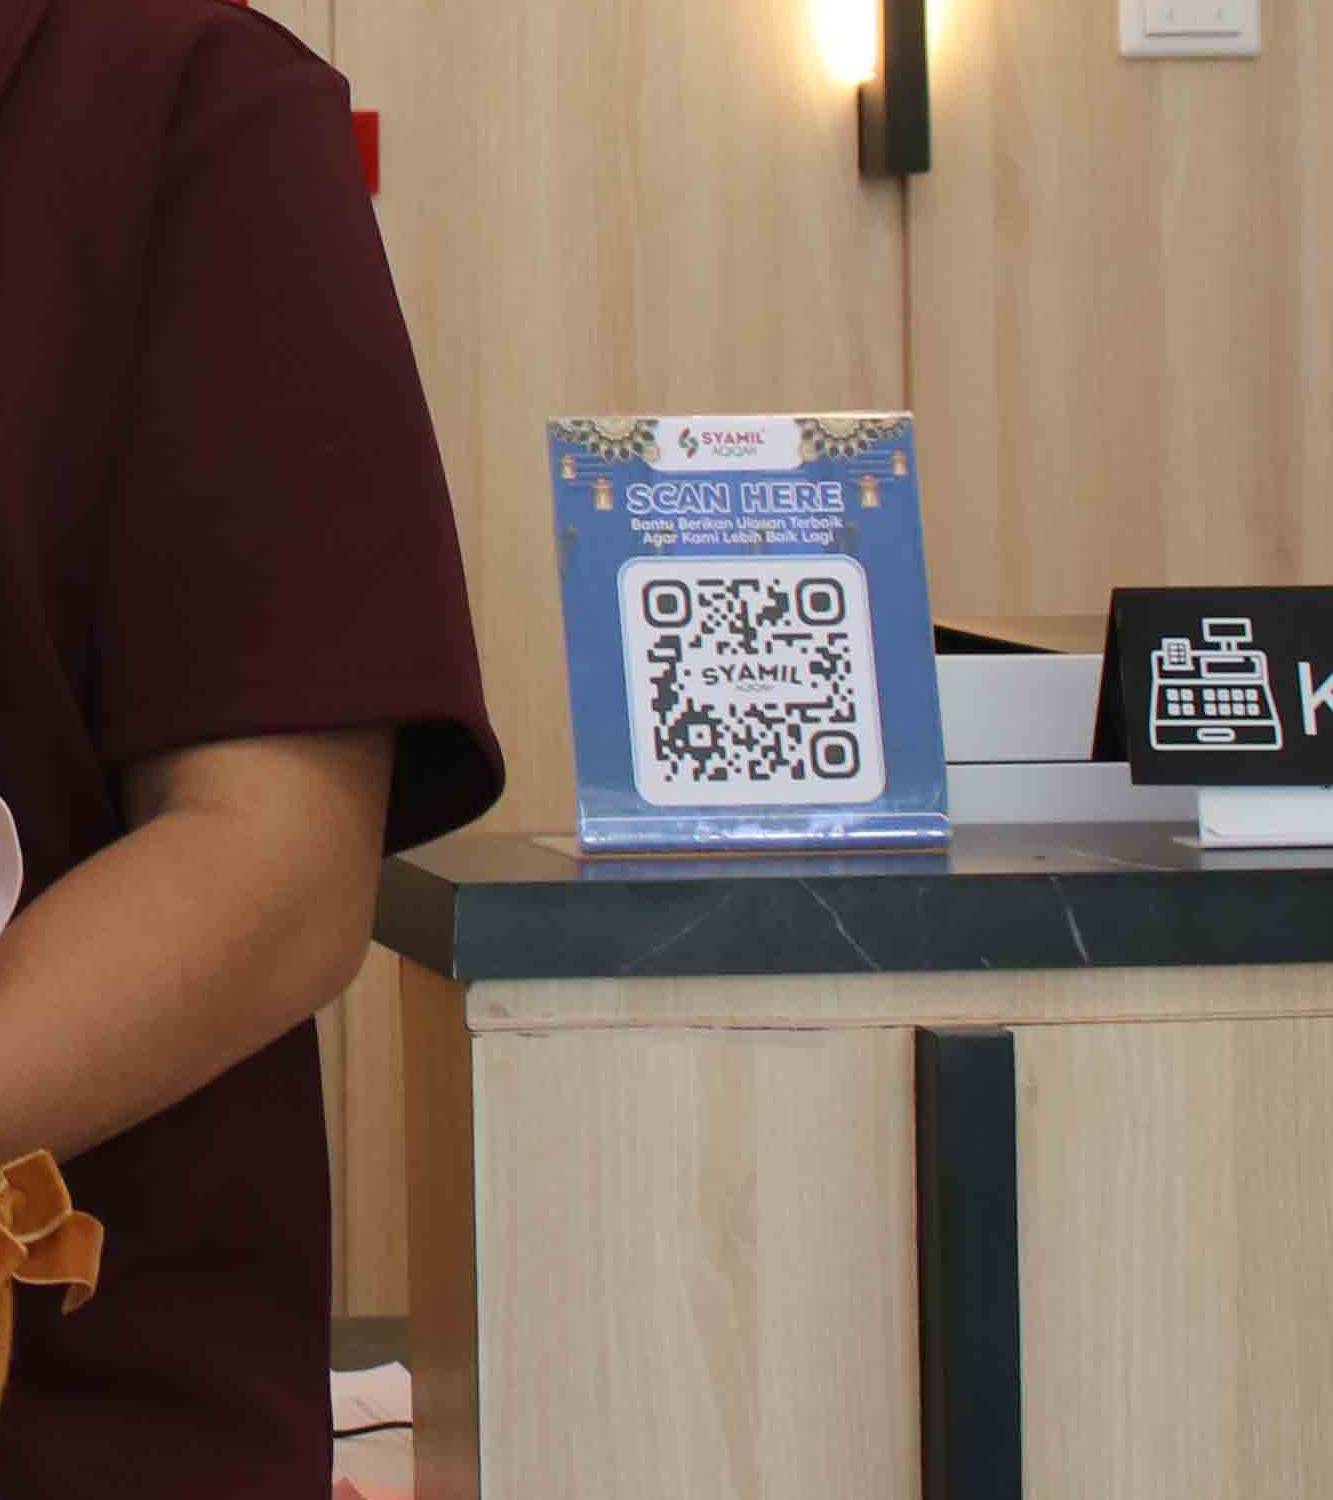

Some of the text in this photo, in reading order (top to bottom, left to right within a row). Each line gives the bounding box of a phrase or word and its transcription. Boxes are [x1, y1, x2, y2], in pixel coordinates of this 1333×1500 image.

[701, 431, 764, 445] SYAMIL
[626, 481, 845, 514] SCAN HERE
[630, 517, 843, 531] Bantu Berikan Ulasan Terbaik
[643, 530, 833, 546] Agar Kami Lebih Baik Lagi
[702, 663, 804, 686] SYAMIL
